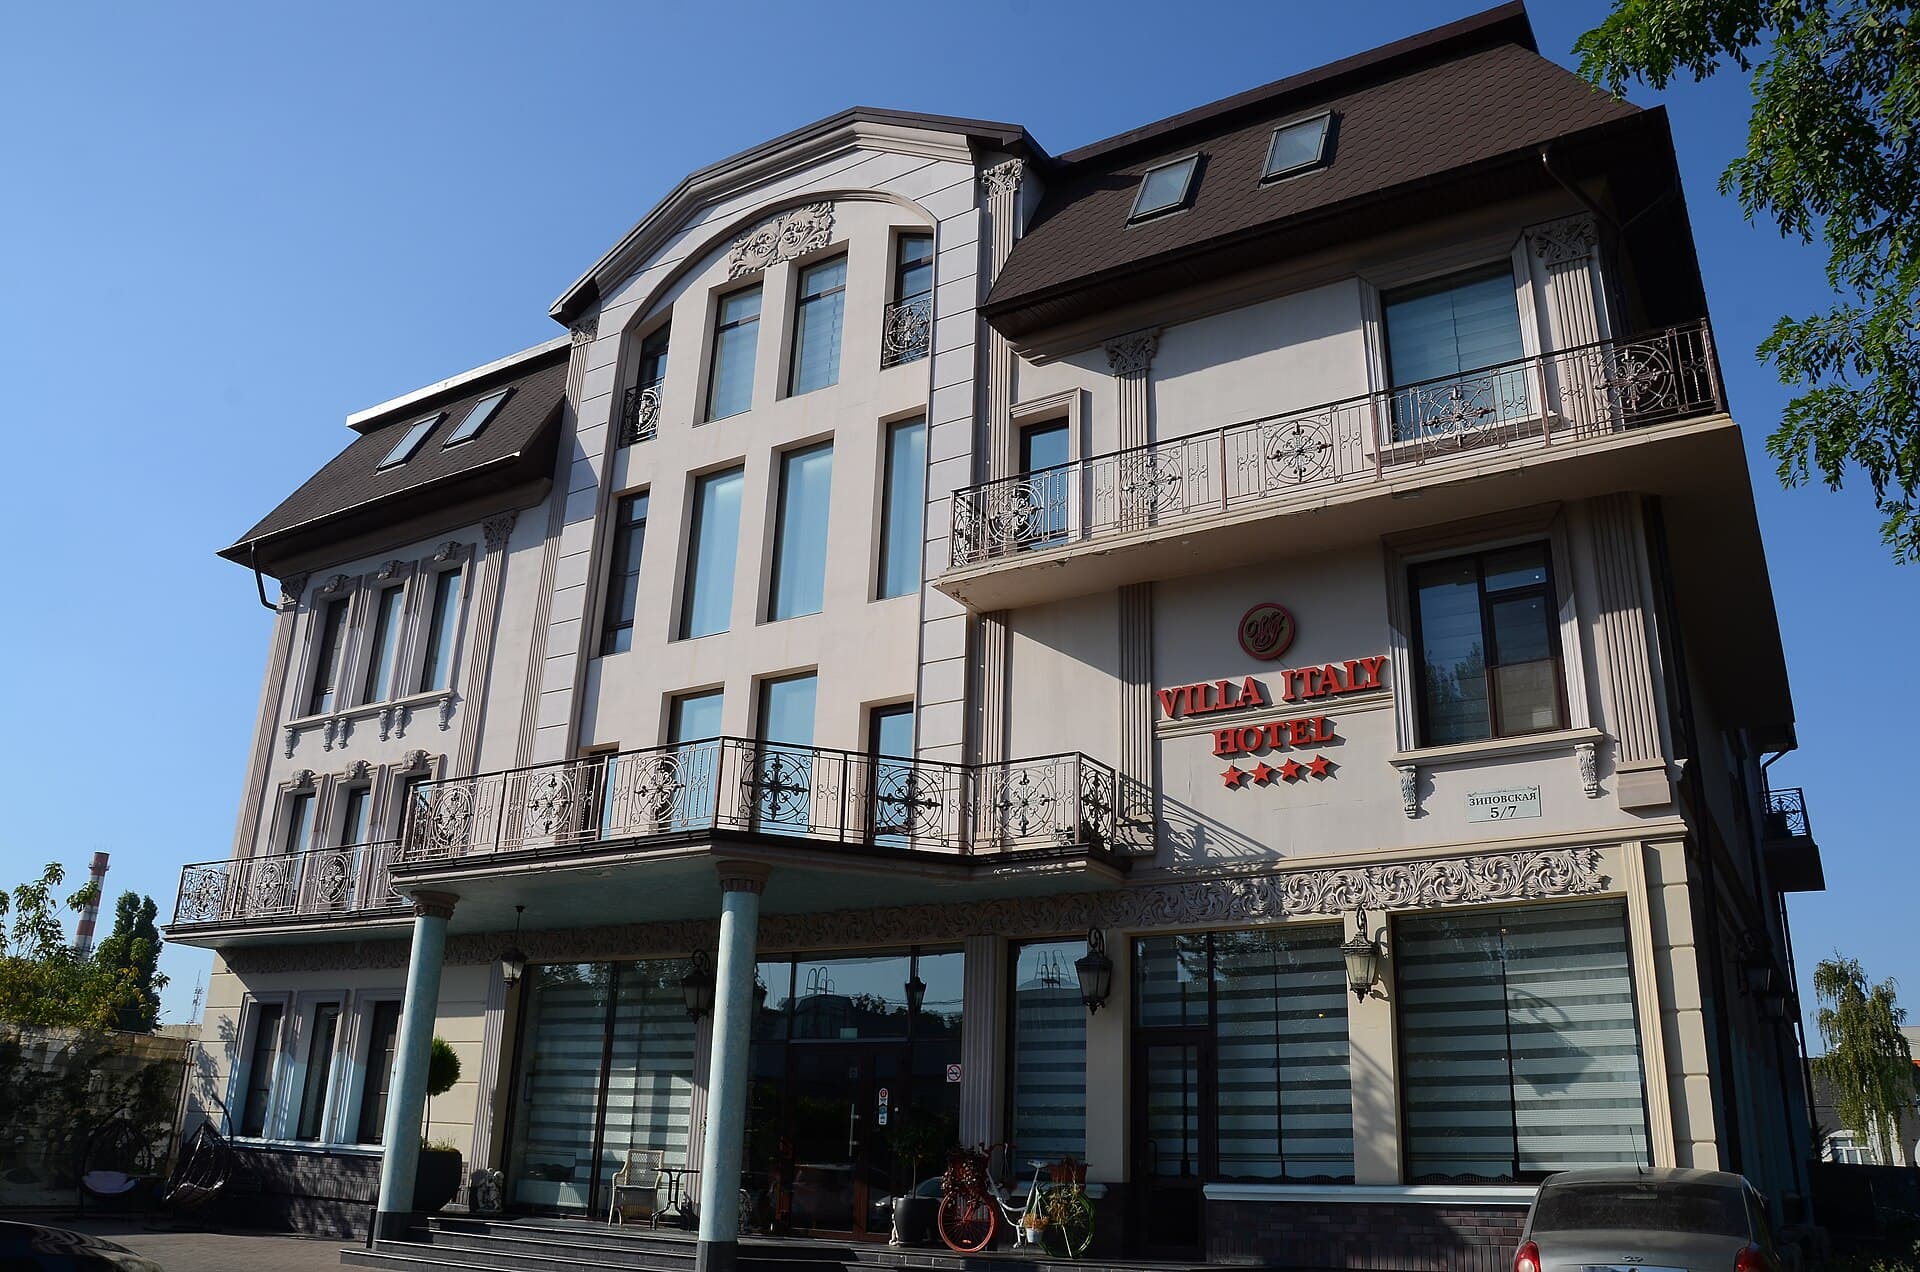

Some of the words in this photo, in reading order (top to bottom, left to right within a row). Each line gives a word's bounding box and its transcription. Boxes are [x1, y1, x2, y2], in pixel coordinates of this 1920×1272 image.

[1156, 676, 1263, 718] VILLA
[1281, 656, 1386, 701] ITALY
[1212, 716, 1334, 755] HOTEL
[1469, 792, 1537, 806] ЗИПОВСКАЯ
[1490, 806, 1517, 818] 5/7
